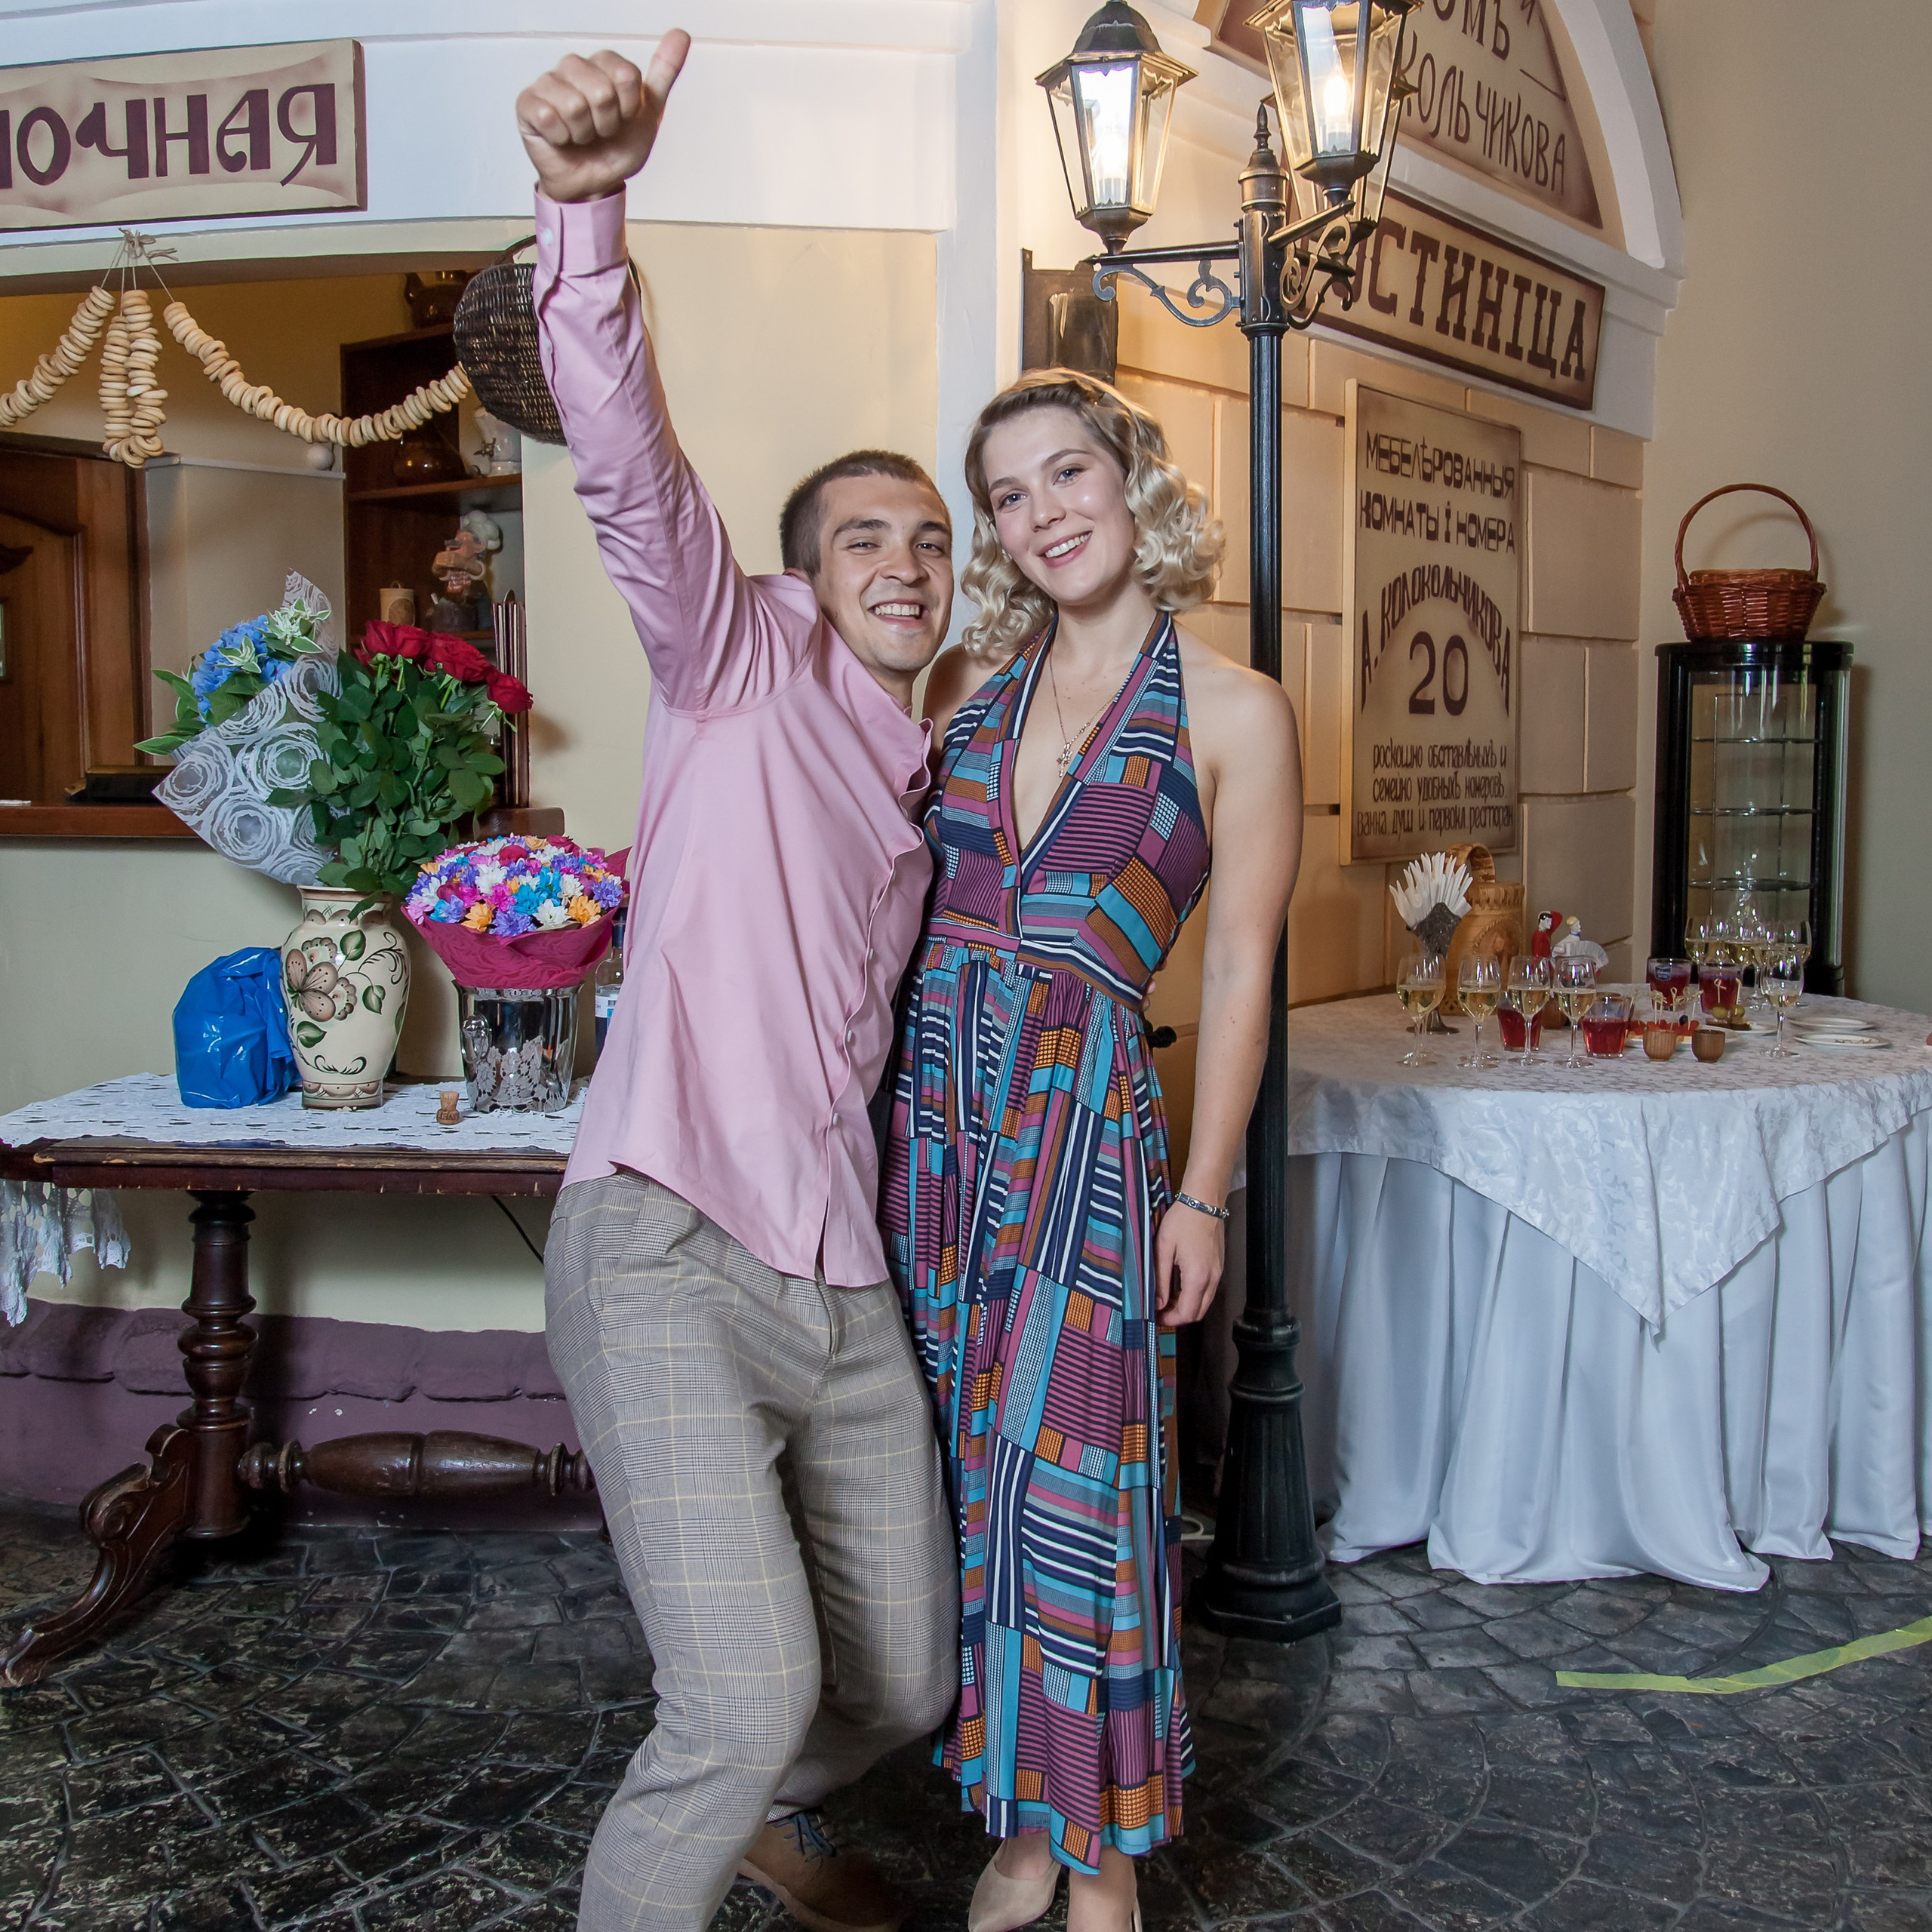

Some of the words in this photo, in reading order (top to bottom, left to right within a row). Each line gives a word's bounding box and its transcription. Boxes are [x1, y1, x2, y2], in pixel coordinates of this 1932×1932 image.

[1300, 217, 1586, 378] СТИНІЦА
[1360, 489, 1439, 542] КОМНАТЫ
[1457, 510, 1515, 555] НОМЕРА
[1380, 564, 1510, 718] КОЛОКОЛЬЧИКОВА
[1409, 631, 1469, 716] 20
[1373, 737, 1423, 774] роскошно
[1500, 745, 1506, 768] и
[1373, 773, 1412, 802] семейно
[1392, 808, 1414, 841] душ
[1419, 808, 1425, 831] и
